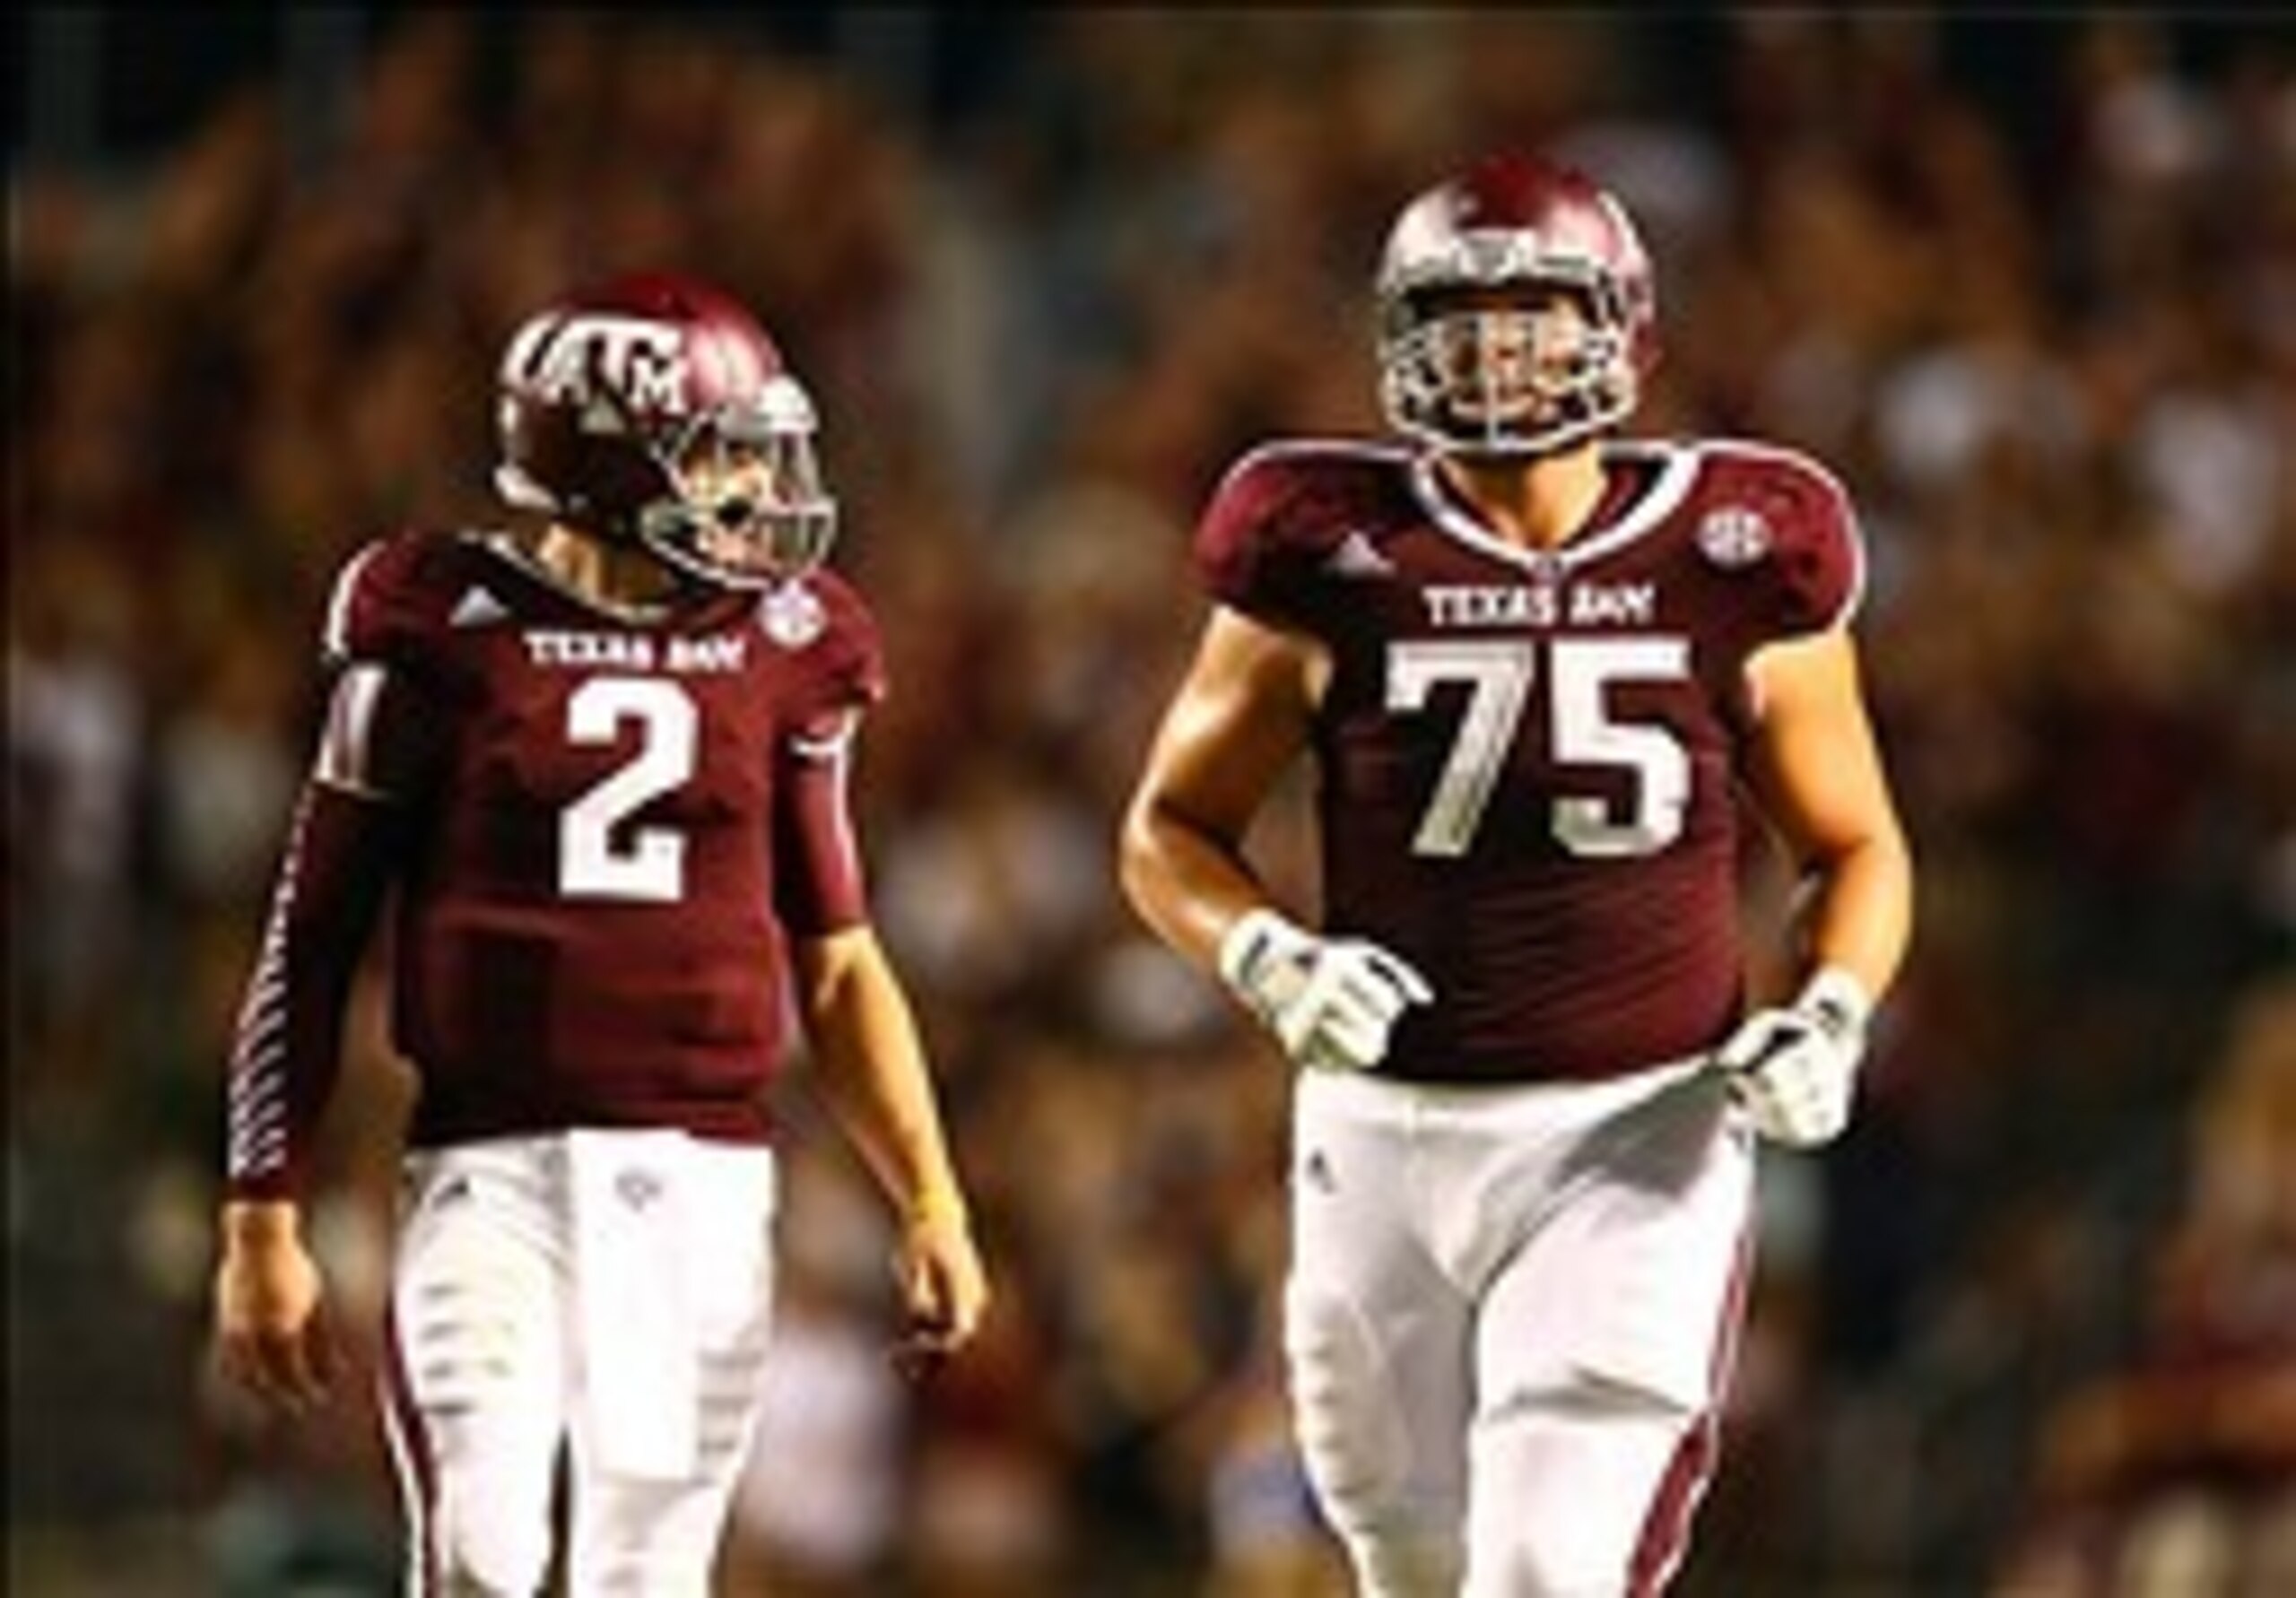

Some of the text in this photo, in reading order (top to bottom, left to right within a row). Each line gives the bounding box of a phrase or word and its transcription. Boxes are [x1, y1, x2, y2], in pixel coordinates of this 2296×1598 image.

[1422, 584, 1559, 628] TEXAS
[558, 675, 700, 903] 2
[1384, 638, 1692, 858] 75
